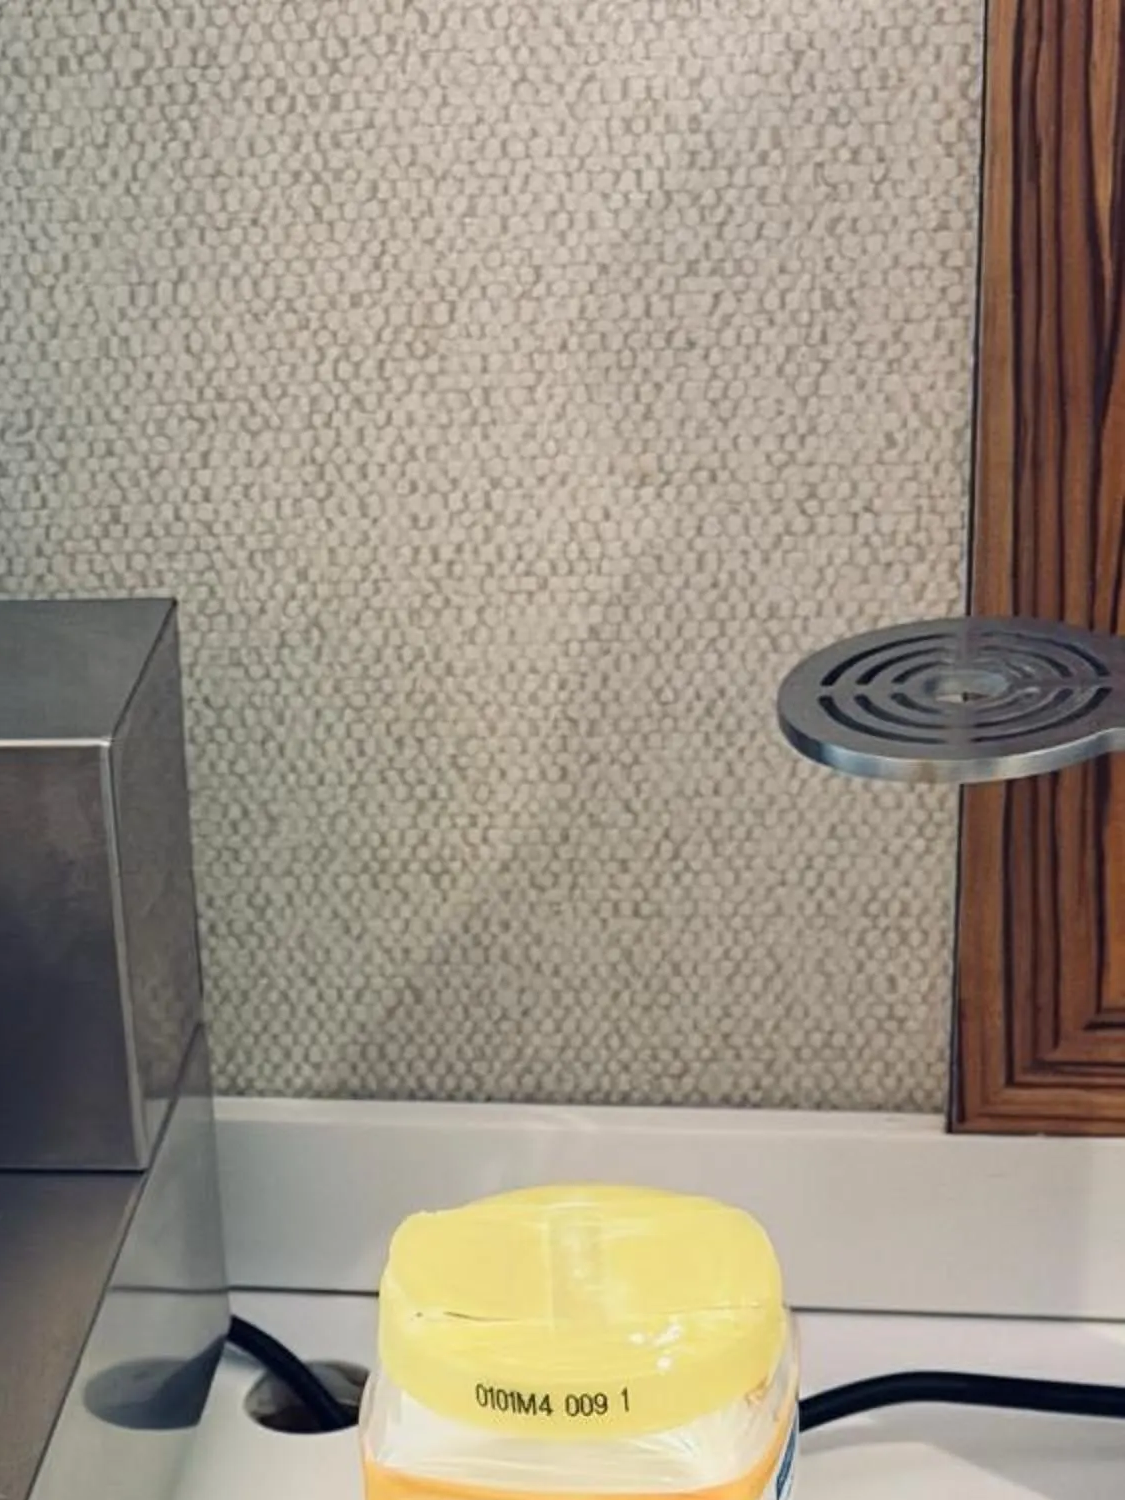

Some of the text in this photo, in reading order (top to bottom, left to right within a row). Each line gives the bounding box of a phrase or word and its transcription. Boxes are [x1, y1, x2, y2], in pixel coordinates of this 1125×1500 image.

[475, 1383, 630, 1417] 0101M4 009 1
